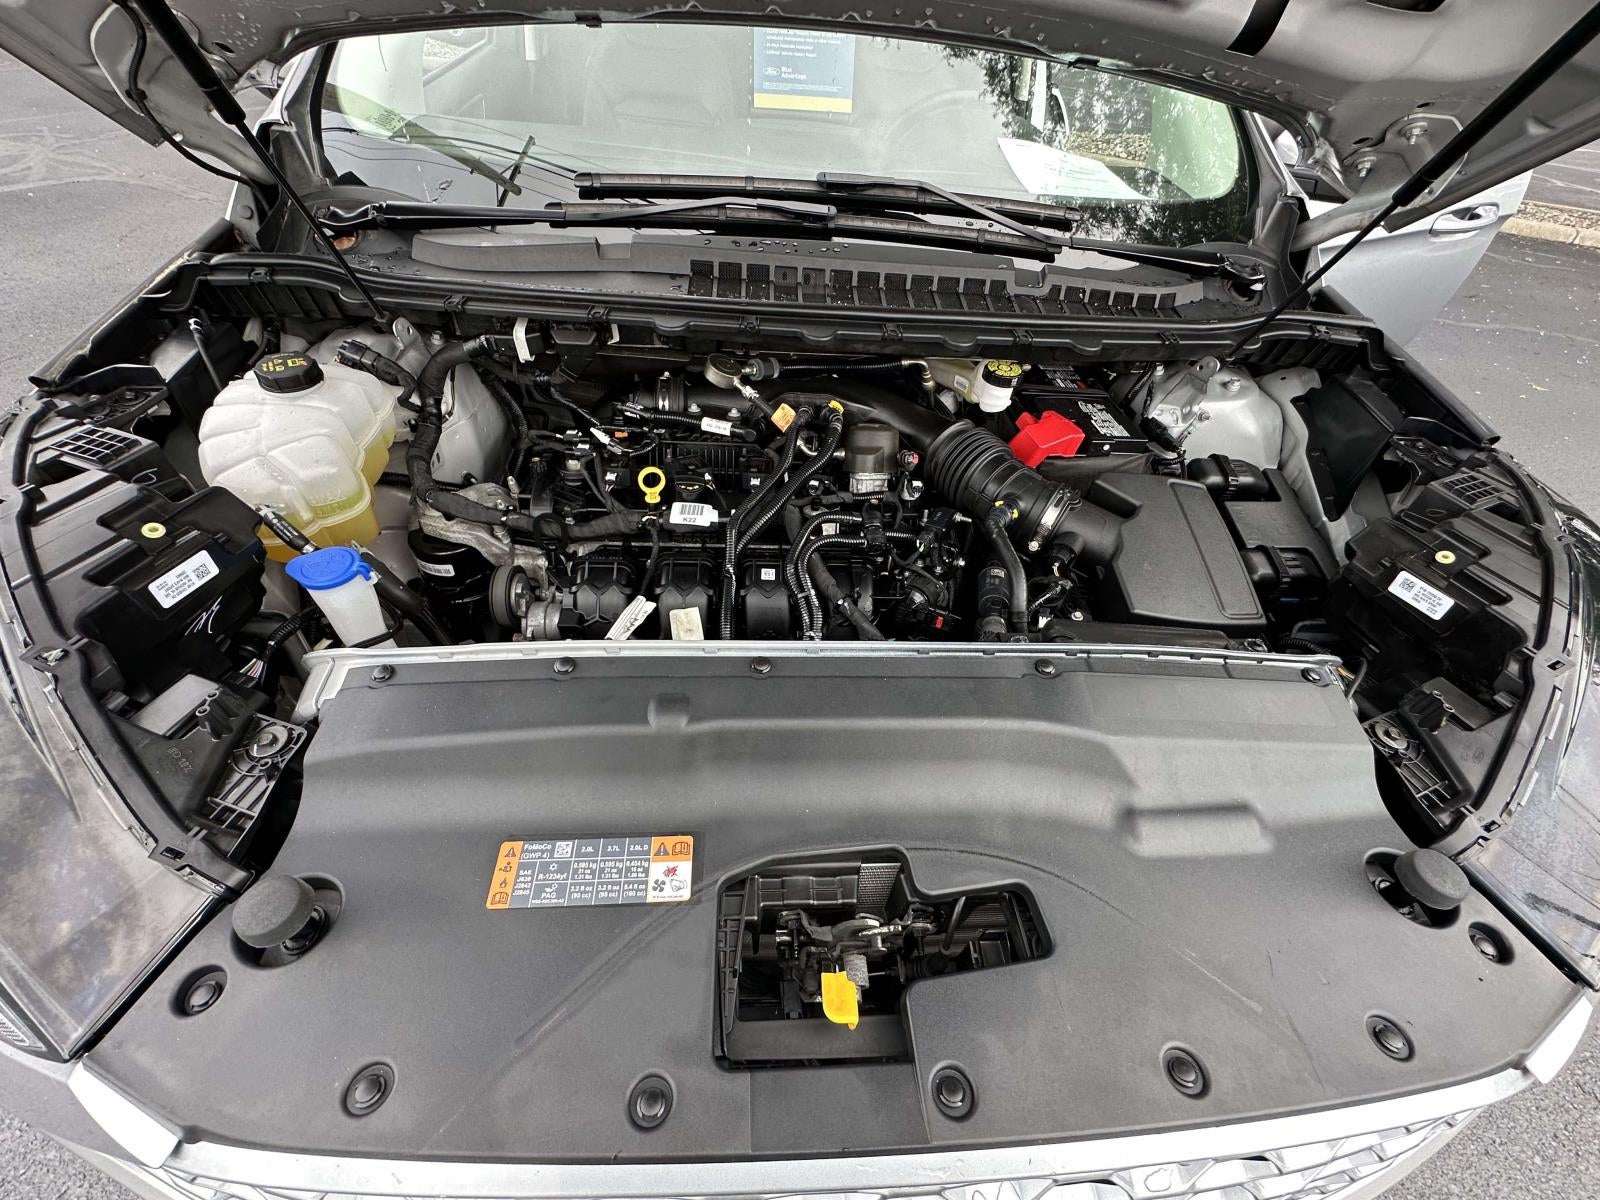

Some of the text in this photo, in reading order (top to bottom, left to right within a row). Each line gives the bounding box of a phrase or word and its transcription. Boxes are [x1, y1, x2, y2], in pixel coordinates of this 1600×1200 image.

[523, 843, 552, 851] FoMoCo
[520, 852, 542, 860] (GWP
[537, 872, 568, 880] R-1234yf
